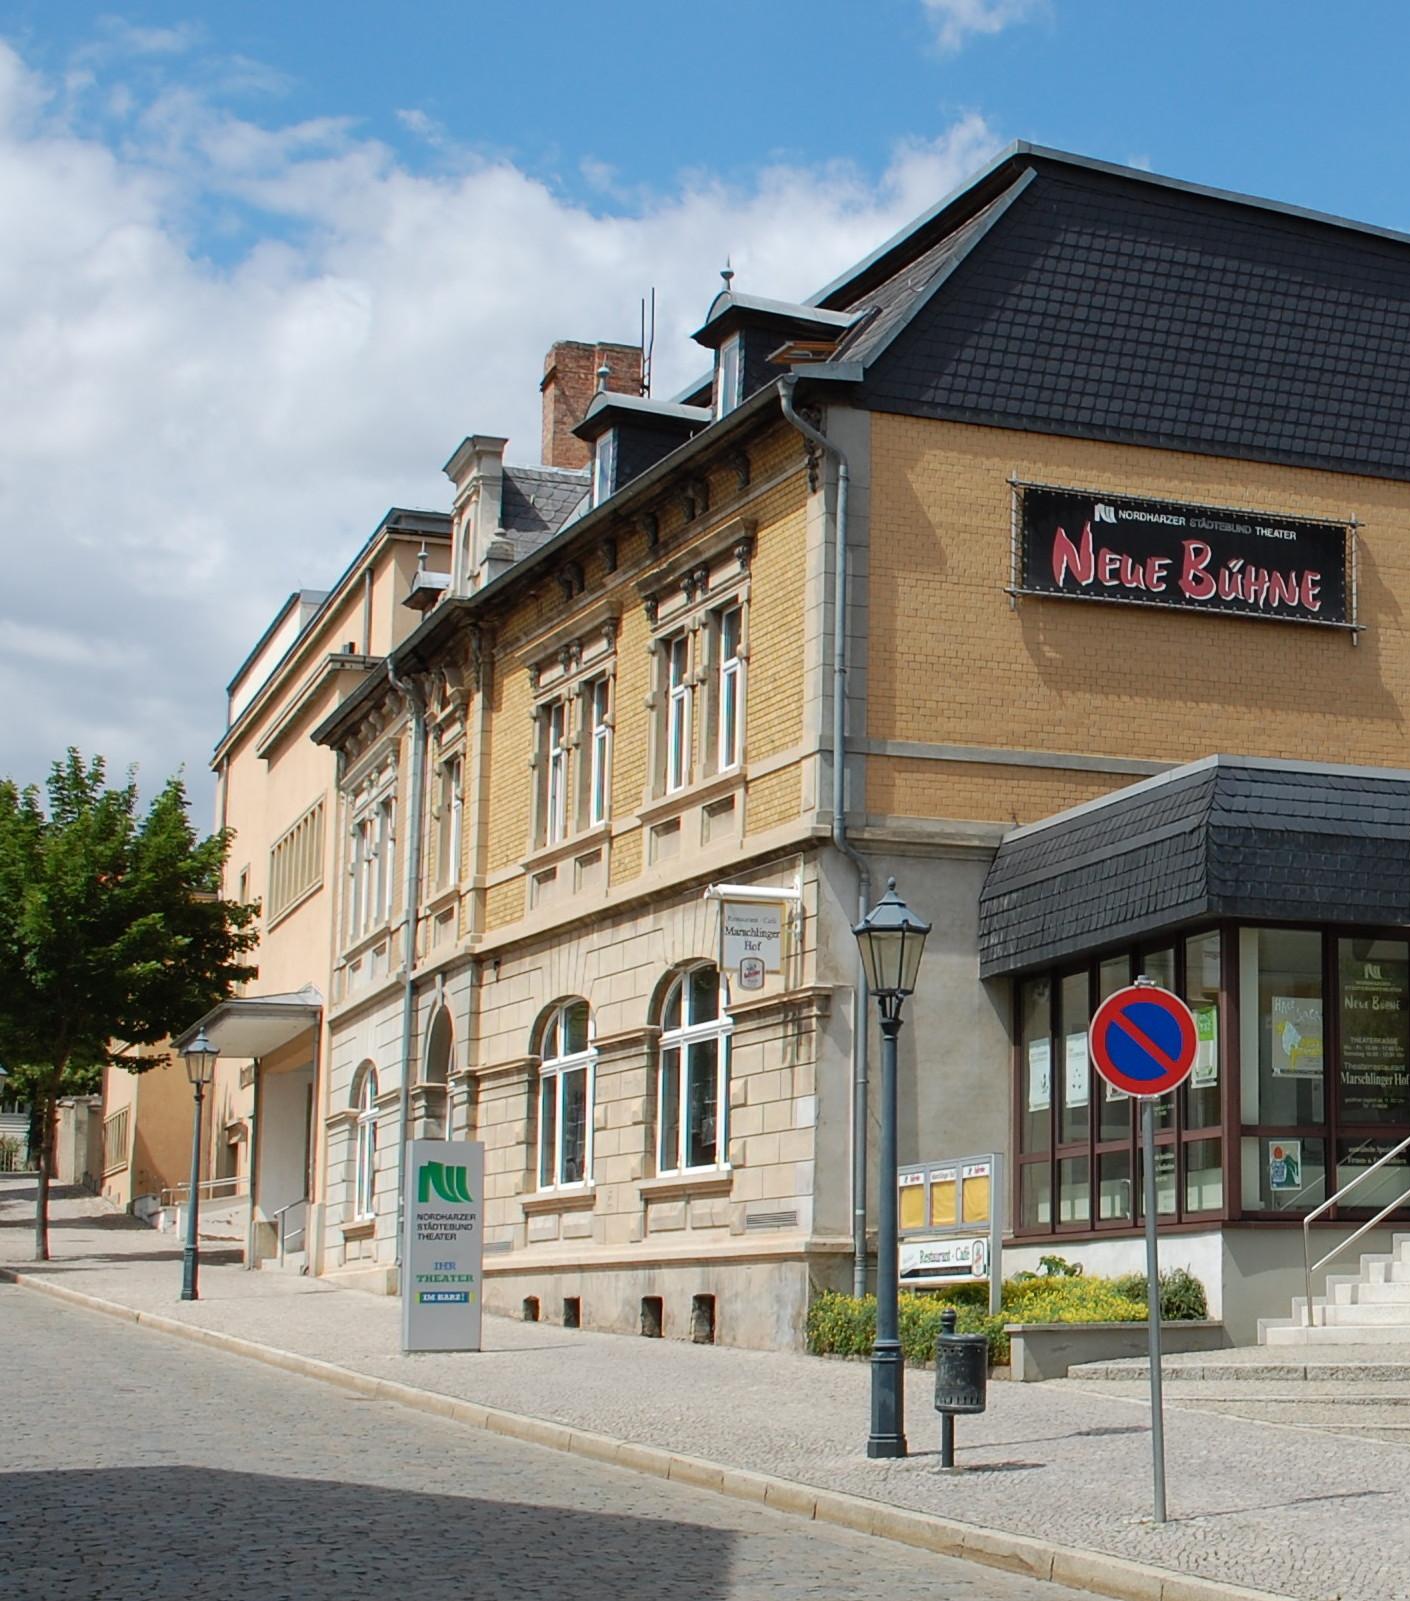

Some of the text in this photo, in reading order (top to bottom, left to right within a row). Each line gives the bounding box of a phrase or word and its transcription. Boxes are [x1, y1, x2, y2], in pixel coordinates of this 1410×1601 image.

[1118, 509, 1297, 541] NORDHARZER STÄDTEBUND THEATER
[1052, 520, 1323, 612] NEUE BÜHNE
[725, 927, 780, 940] Marschlinger
[744, 940, 762, 951] Hof
[1340, 1072, 1409, 1087] Marschlinger Hof
[417, 1213, 476, 1221] NORDHARZER
[417, 1223, 473, 1231] STÄDTEBUND
[417, 1233, 456, 1241] THEATER
[433, 1261, 456, 1271] IHR
[416, 1274, 474, 1283] THEATER
